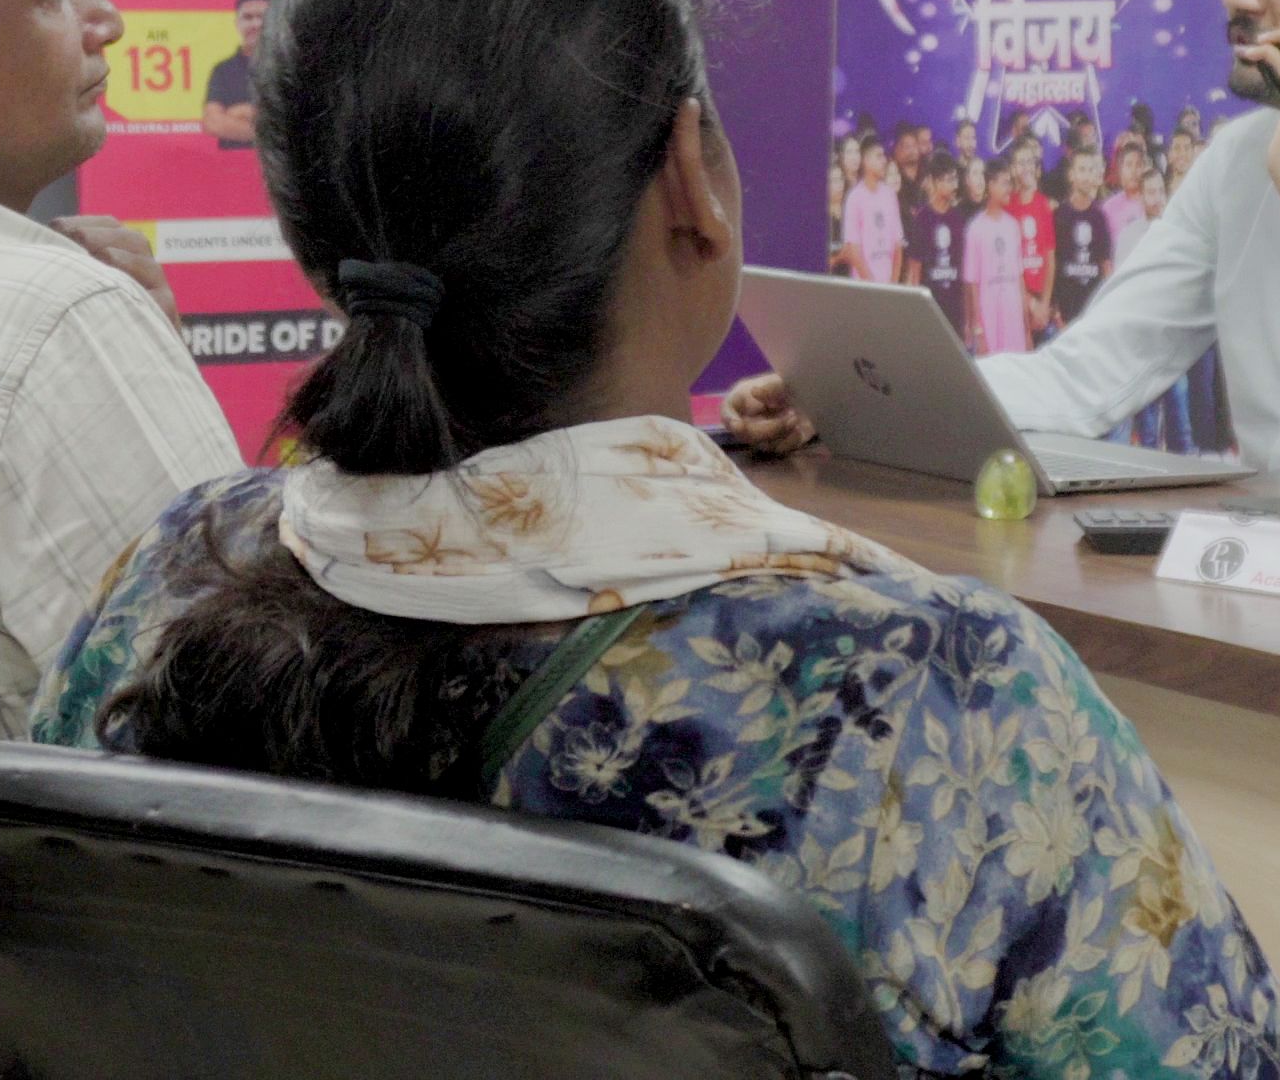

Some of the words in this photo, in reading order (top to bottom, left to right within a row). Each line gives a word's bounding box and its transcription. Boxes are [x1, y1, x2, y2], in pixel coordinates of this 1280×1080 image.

[125, 45, 193, 93] 131
[165, 236, 229, 250] STUDENTS
[271, 321, 317, 351] OF
